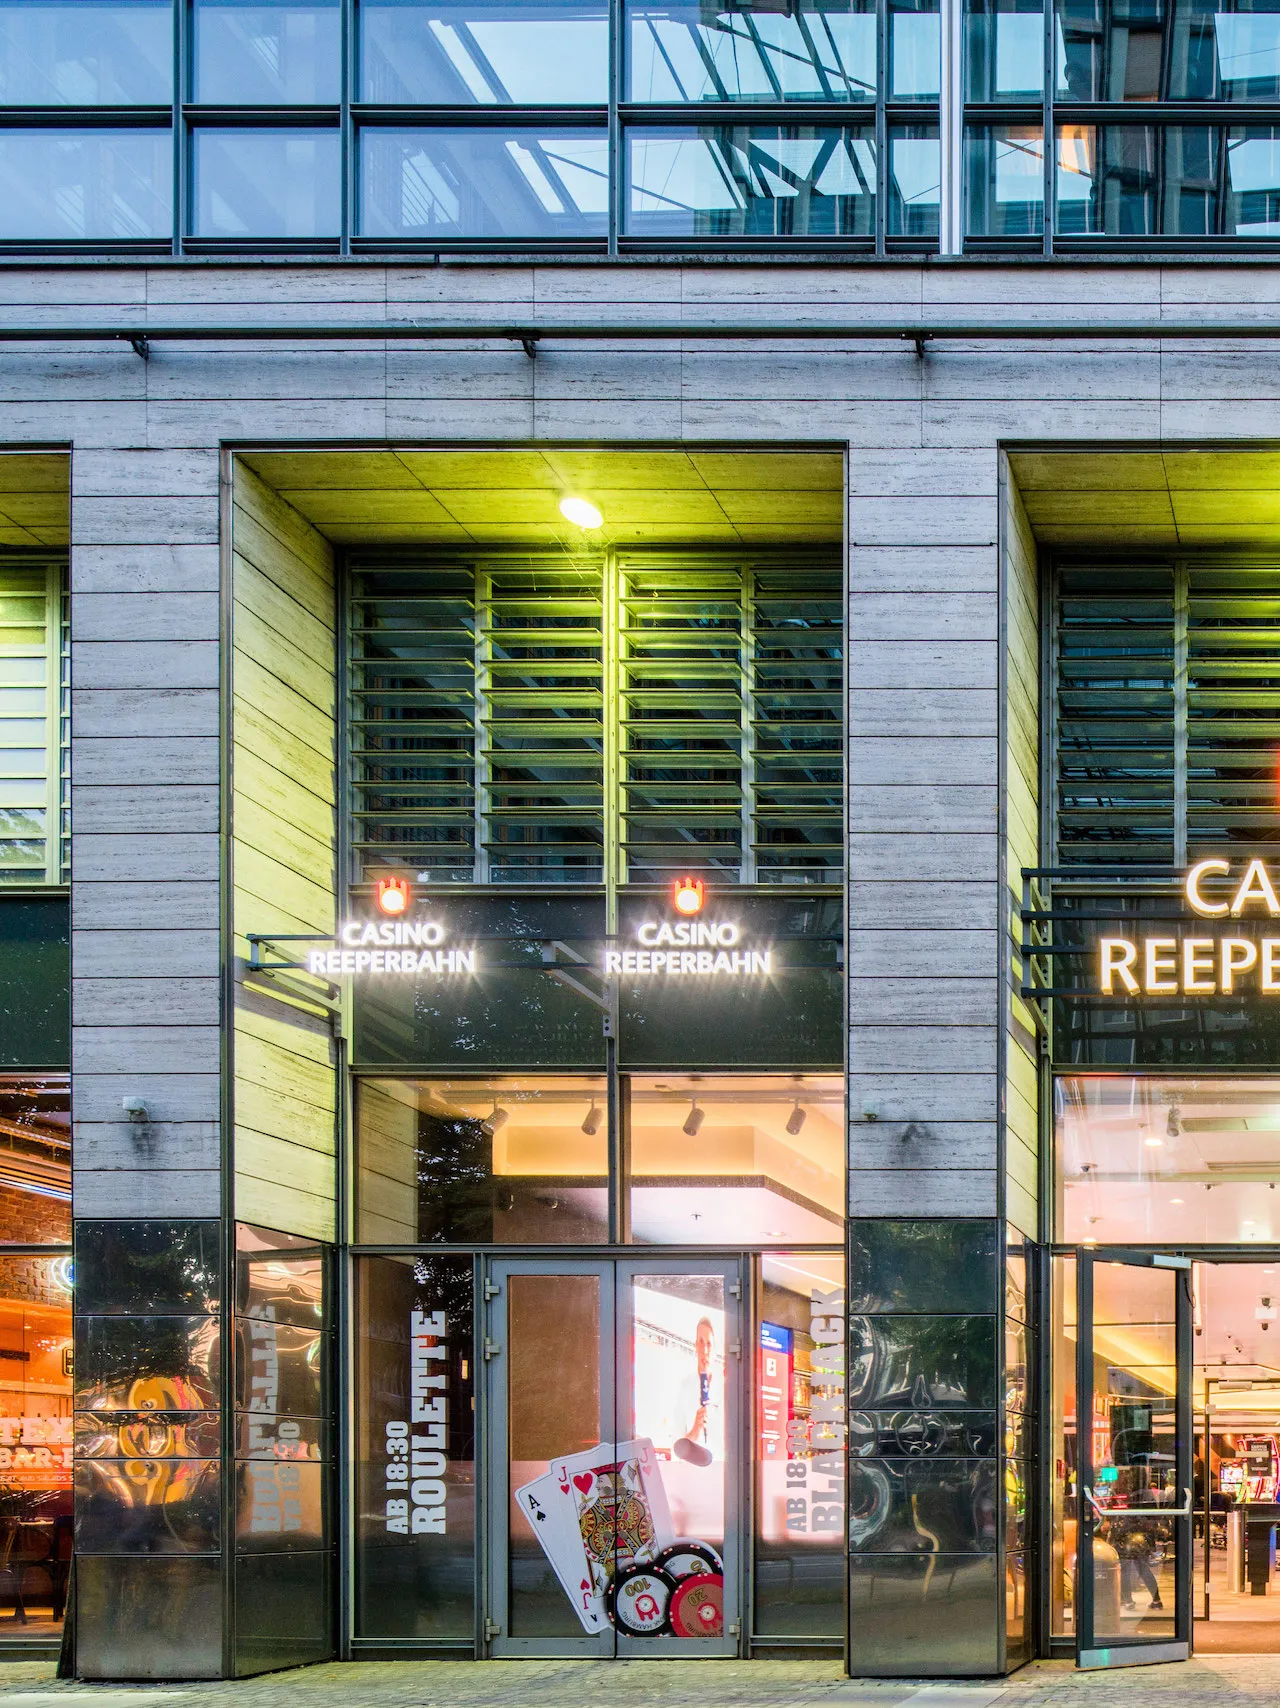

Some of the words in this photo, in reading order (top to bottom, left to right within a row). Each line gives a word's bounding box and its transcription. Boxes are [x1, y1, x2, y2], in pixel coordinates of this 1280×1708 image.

[342, 922, 444, 946] CASINO
[637, 922, 740, 946] CASINO
[308, 950, 477, 974] REEPERBAHN
[604, 950, 772, 974] REEPERBAHN
[411, 1310, 447, 1535] ROULETTE
[810, 1288, 845, 1533] BLACKJACK
[386, 1421, 409, 1491] 18:30
[558, 1466, 568, 1482] J
[528, 1493, 541, 1510] A
[386, 1499, 409, 1535] AB
[786, 1498, 807, 1533] AB
[624, 1577, 652, 1597] 100
[687, 1587, 709, 1607] 20
[621, 1611, 653, 1631] HAMBURG
